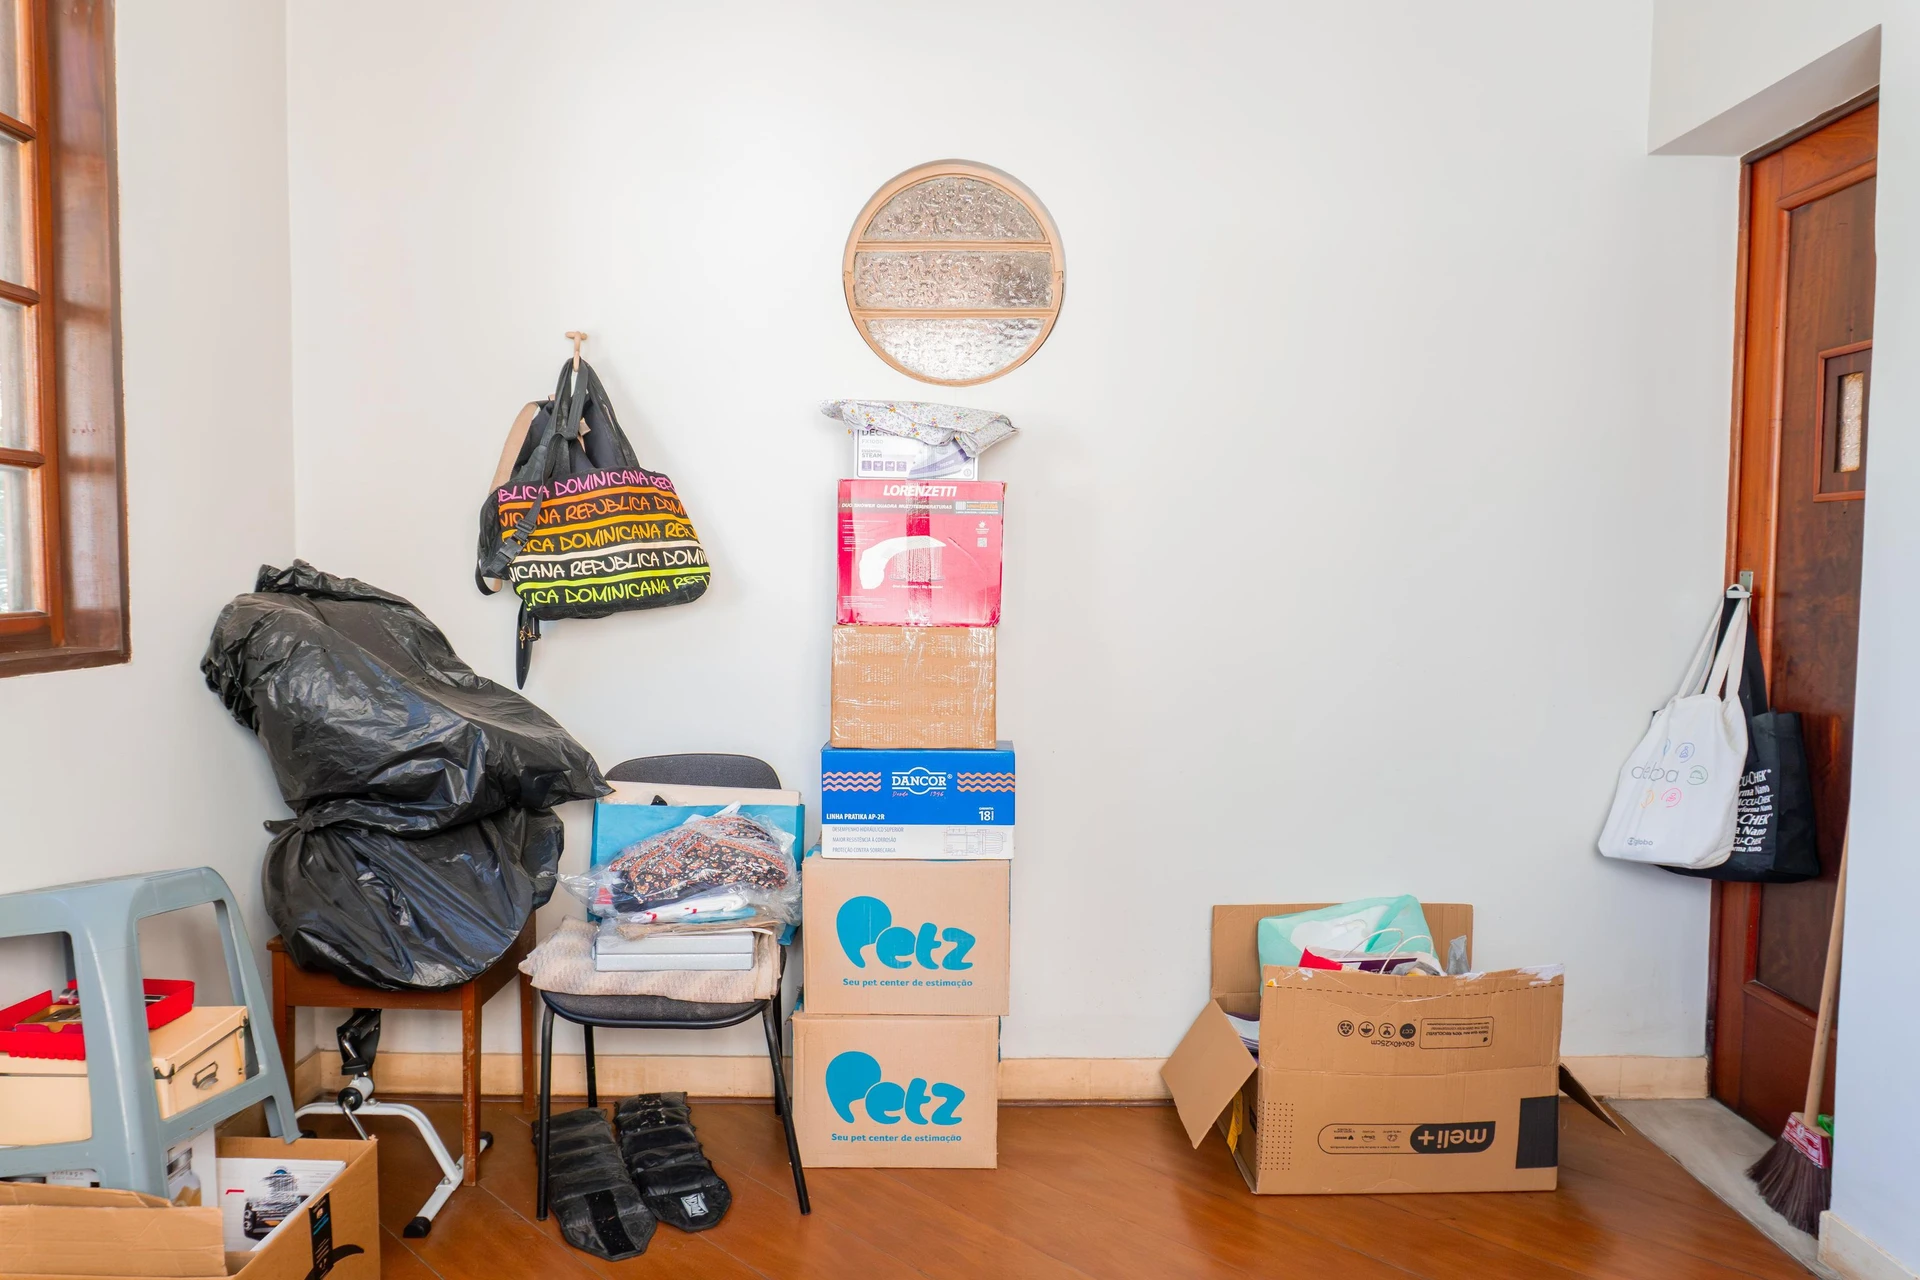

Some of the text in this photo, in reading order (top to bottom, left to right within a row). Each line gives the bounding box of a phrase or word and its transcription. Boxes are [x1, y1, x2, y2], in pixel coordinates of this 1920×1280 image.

[554, 470, 649, 497] DOMINICANA
[883, 485, 957, 497] LORENZETTI
[565, 495, 650, 522] REPUBLICA
[560, 522, 661, 551] DOMINICANA
[570, 551, 660, 578] REPUBLICA
[565, 578, 671, 604] DOMINICANA
[891, 775, 947, 787] DANCOR
[978, 810, 991, 821] 18
[1742, 826, 1767, 836] Nano
[836, 895, 976, 970] Petz
[842, 978, 860, 986] Seu
[862, 979, 878, 988] pet
[912, 978, 923, 986] de
[925, 978, 973, 988] estimação
[1370, 1039, 1415, 1048] 60x40x25cm
[825, 1051, 966, 1125] Petz
[831, 1133, 962, 1143] Seu pet center de estimação
[1417, 1128, 1487, 1149] meli+
